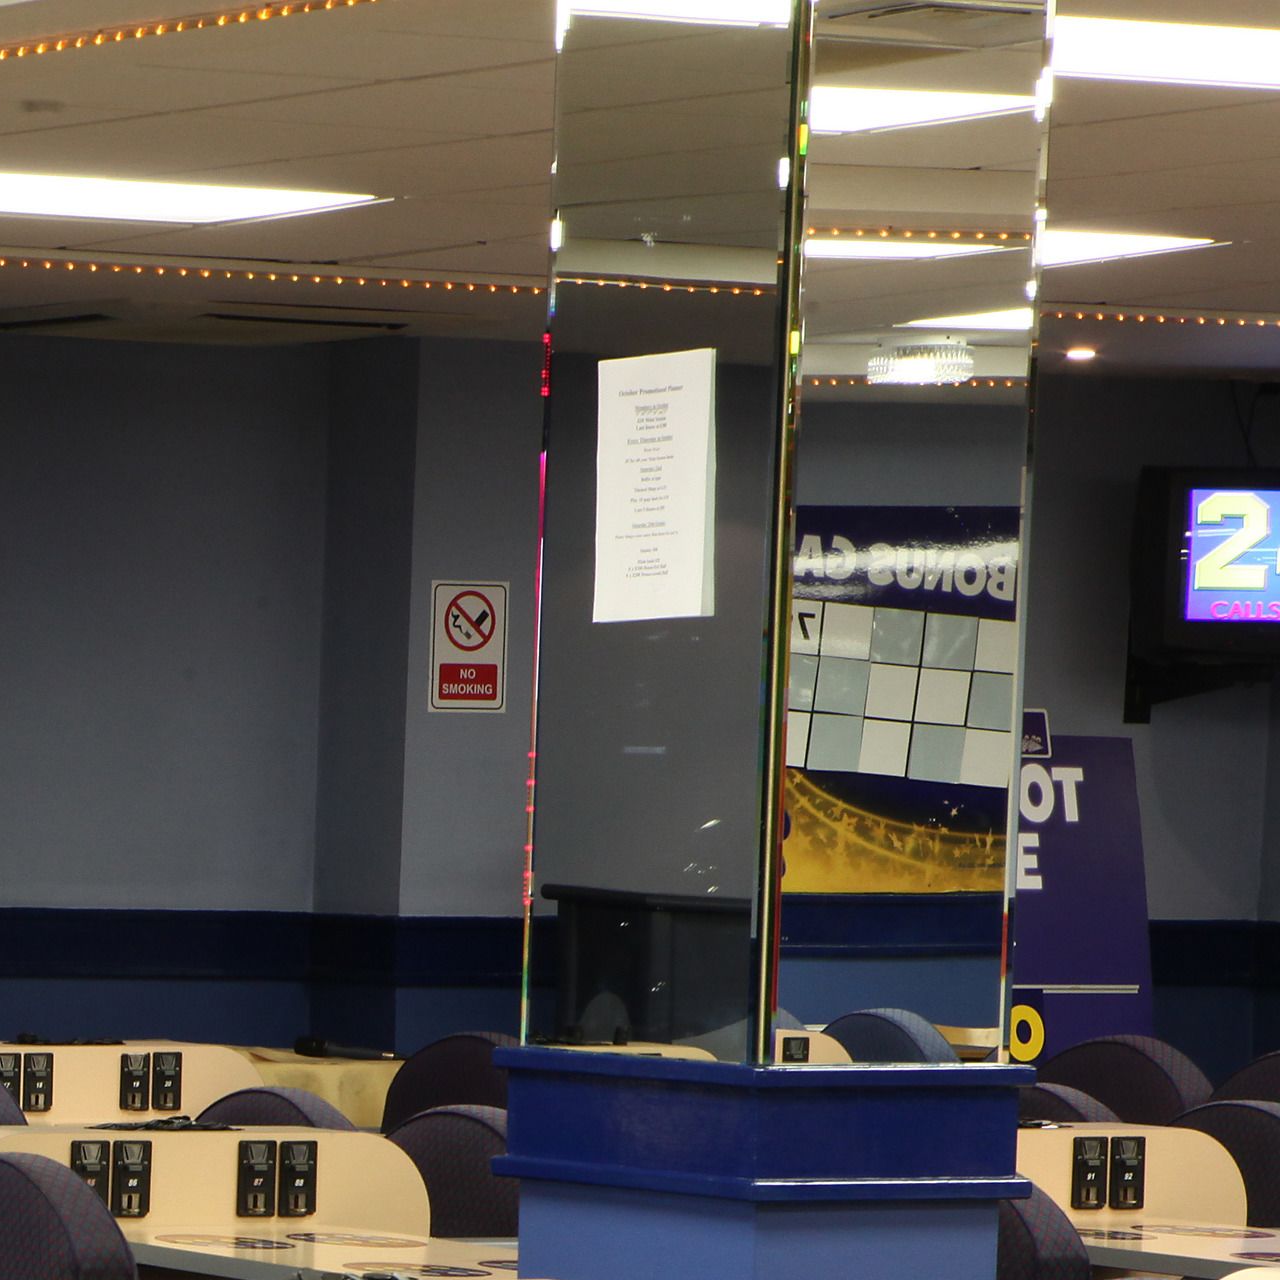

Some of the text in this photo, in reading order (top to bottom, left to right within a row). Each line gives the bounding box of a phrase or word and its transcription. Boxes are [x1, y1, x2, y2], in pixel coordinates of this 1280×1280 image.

[1193, 492, 1280, 592] 2
[459, 668, 476, 679] NO
[442, 683, 492, 695] SMOKING
